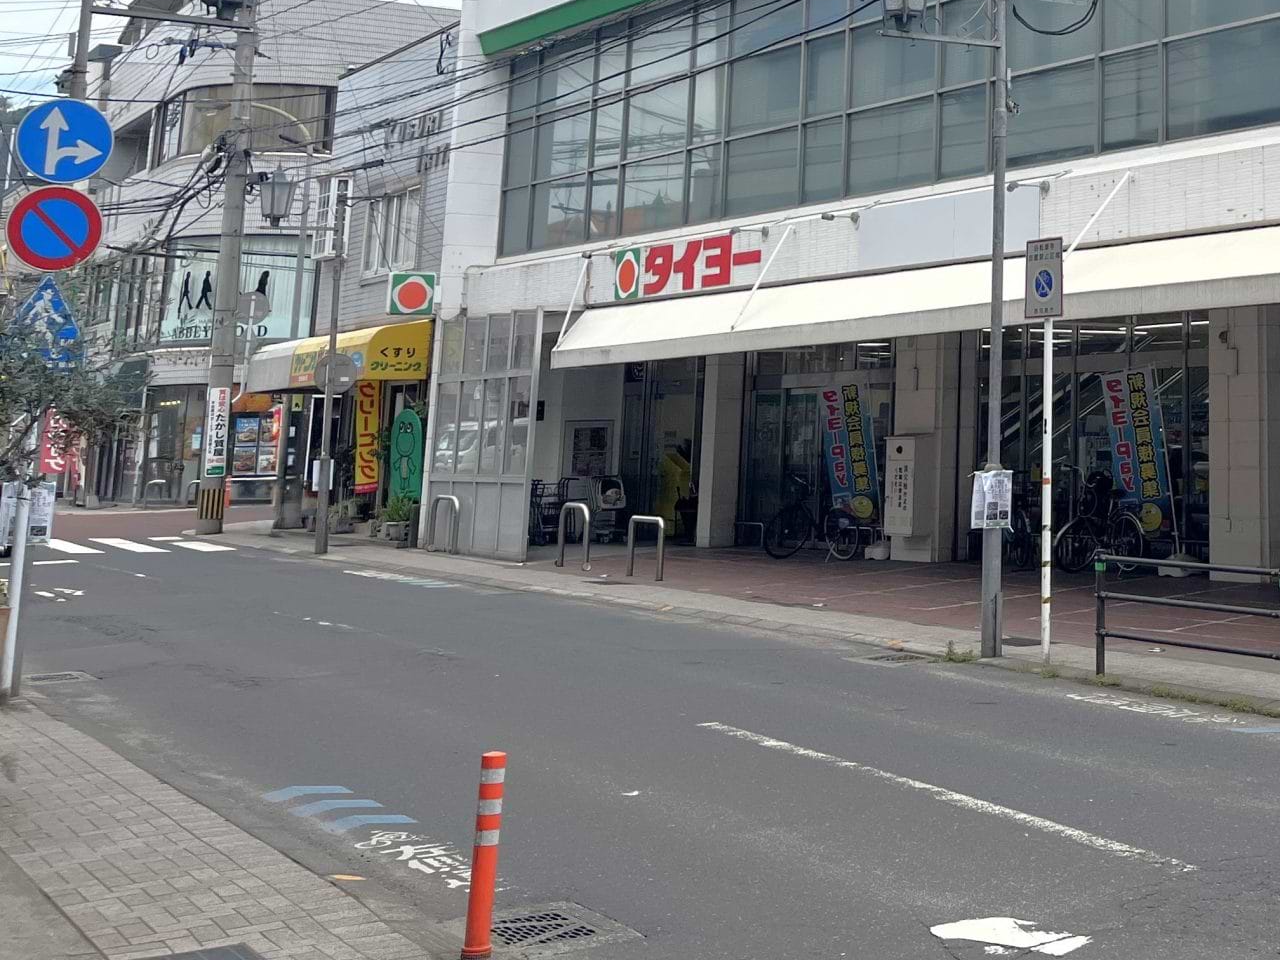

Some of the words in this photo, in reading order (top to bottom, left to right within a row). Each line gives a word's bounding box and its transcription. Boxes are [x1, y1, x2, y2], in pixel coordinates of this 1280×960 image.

[643, 234, 761, 295] タイヨー
[380, 347, 416, 359] くすり
[370, 361, 422, 372] クリーニング
